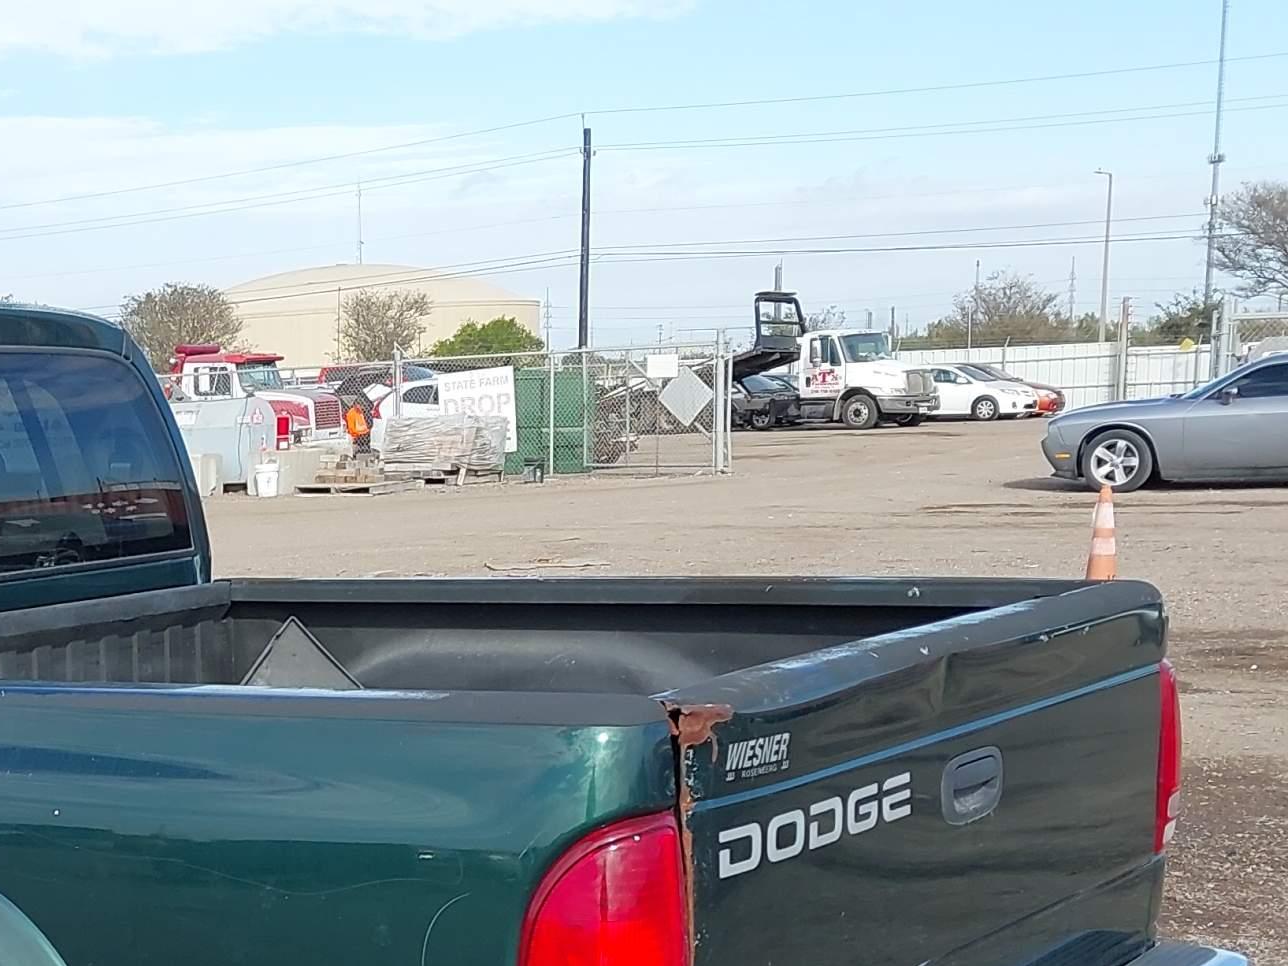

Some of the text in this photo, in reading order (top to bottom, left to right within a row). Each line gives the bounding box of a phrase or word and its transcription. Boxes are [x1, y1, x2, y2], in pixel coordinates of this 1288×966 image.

[444, 375, 509, 392] STATE FARM
[725, 732, 791, 771] WIESNER
[719, 771, 912, 879] DODGE
